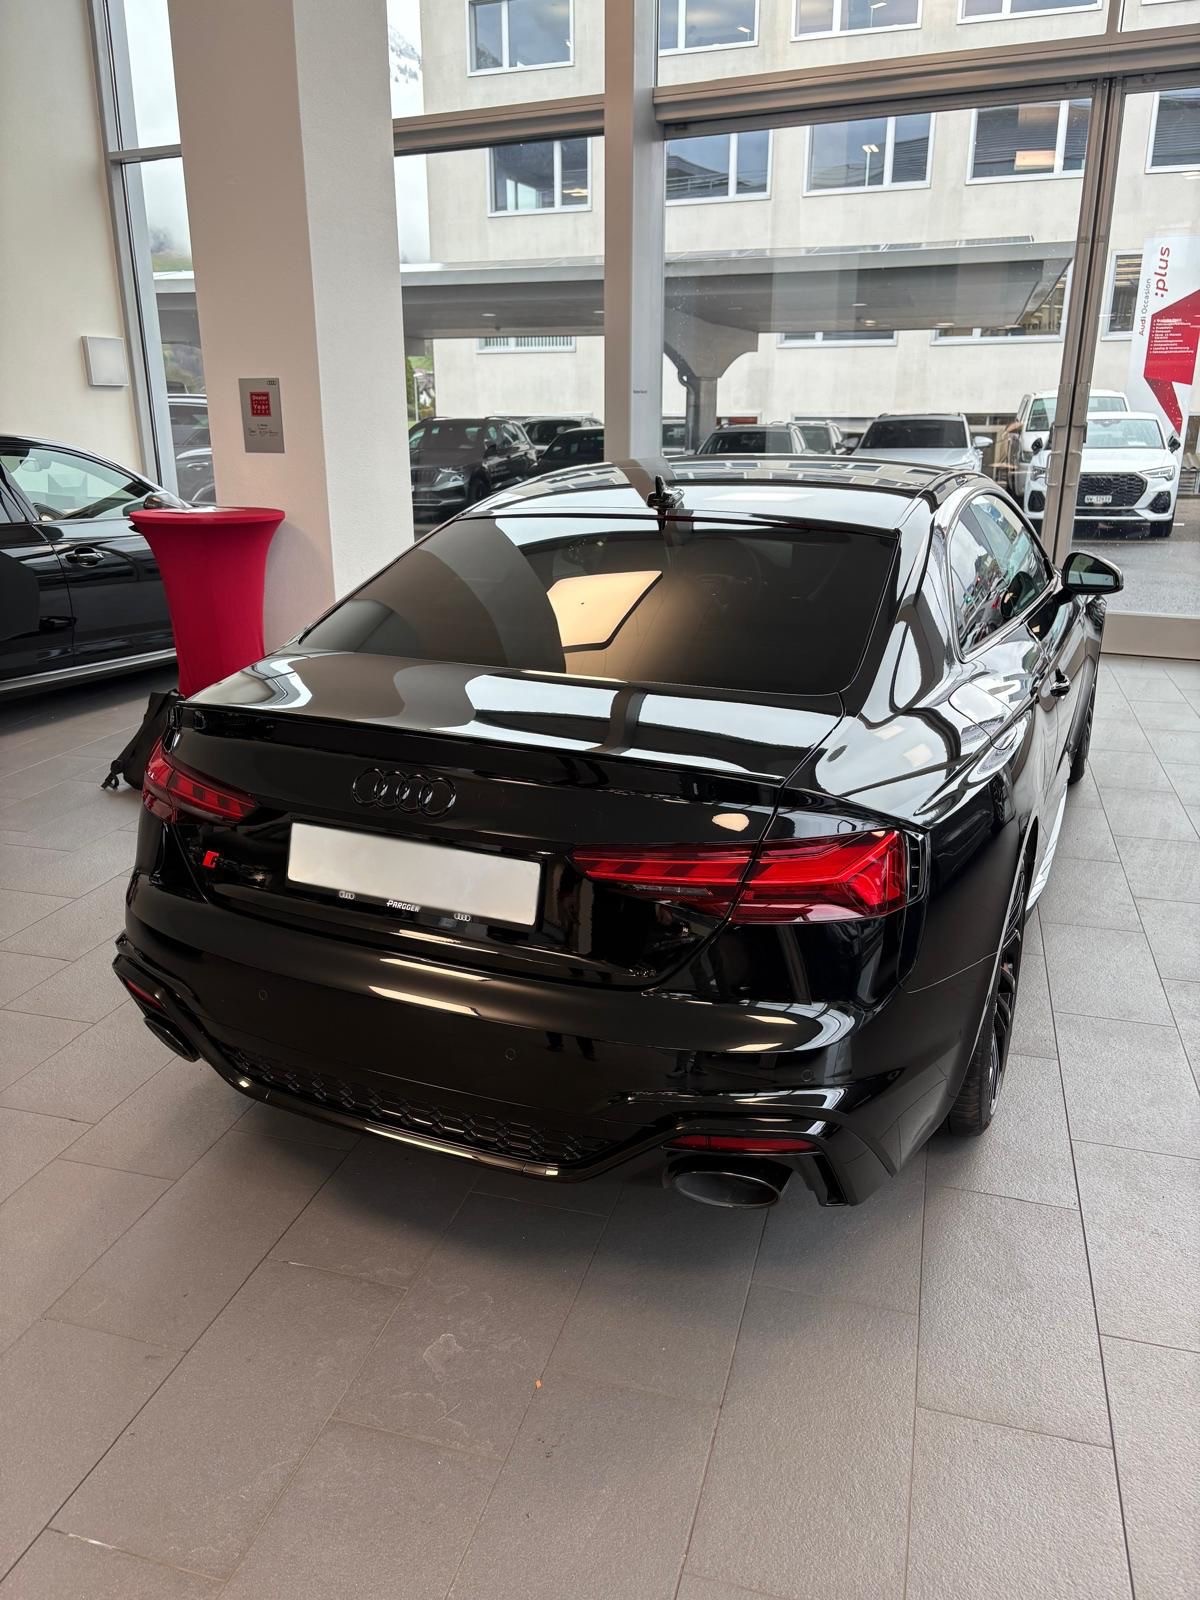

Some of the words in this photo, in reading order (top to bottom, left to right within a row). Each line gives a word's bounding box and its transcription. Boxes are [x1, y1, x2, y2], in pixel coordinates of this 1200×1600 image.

[1154, 246, 1171, 298] :plus
[1141, 279, 1151, 314] Occasion
[1139, 316, 1147, 336] Audi
